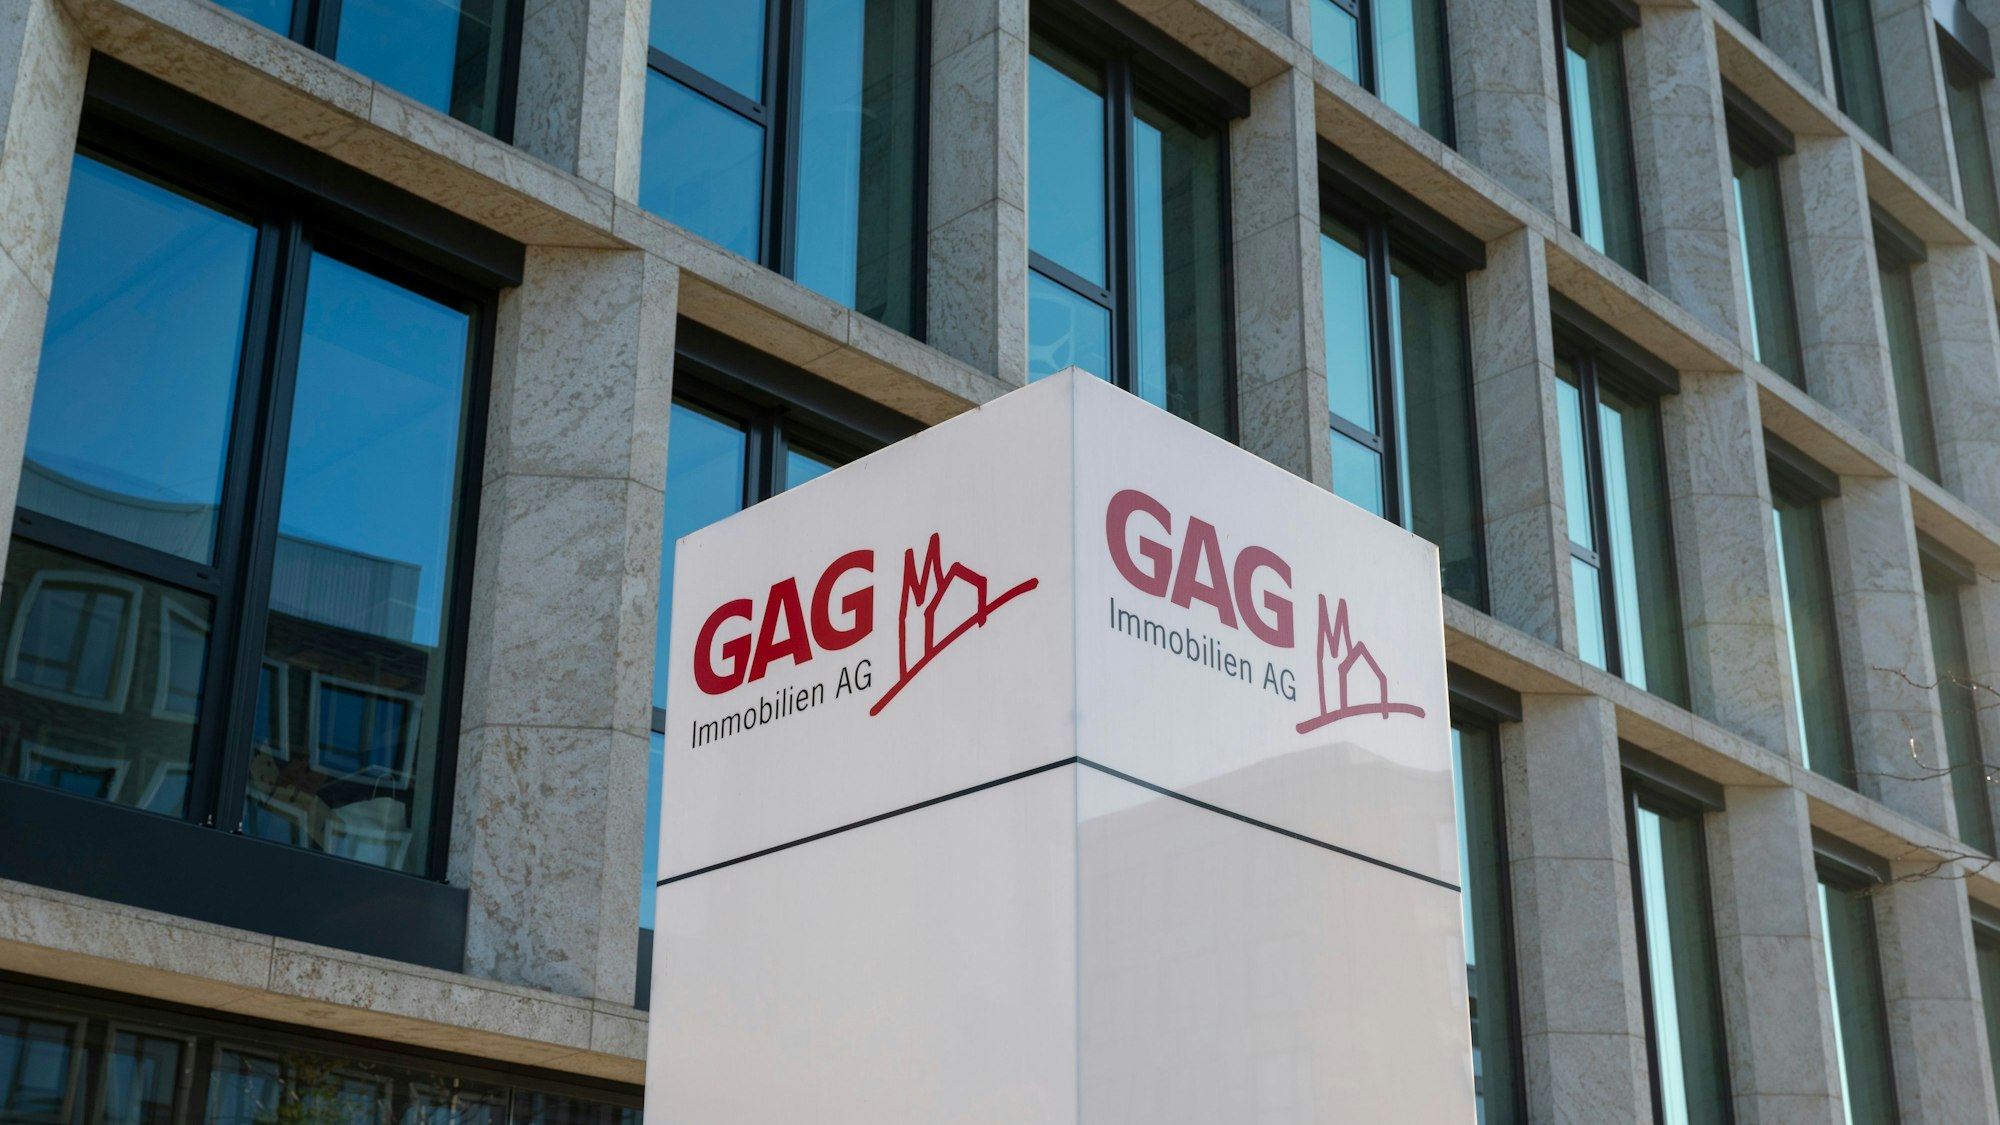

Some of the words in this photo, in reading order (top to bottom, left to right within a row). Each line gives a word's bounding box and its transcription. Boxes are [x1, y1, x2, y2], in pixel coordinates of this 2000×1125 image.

[692, 549, 875, 696] GAG
[1106, 489, 1294, 648] GAG
[692, 682, 825, 749] Immobilien
[834, 658, 873, 701] AG
[1109, 597, 1253, 685] Immobilien
[1262, 662, 1297, 703] AG
